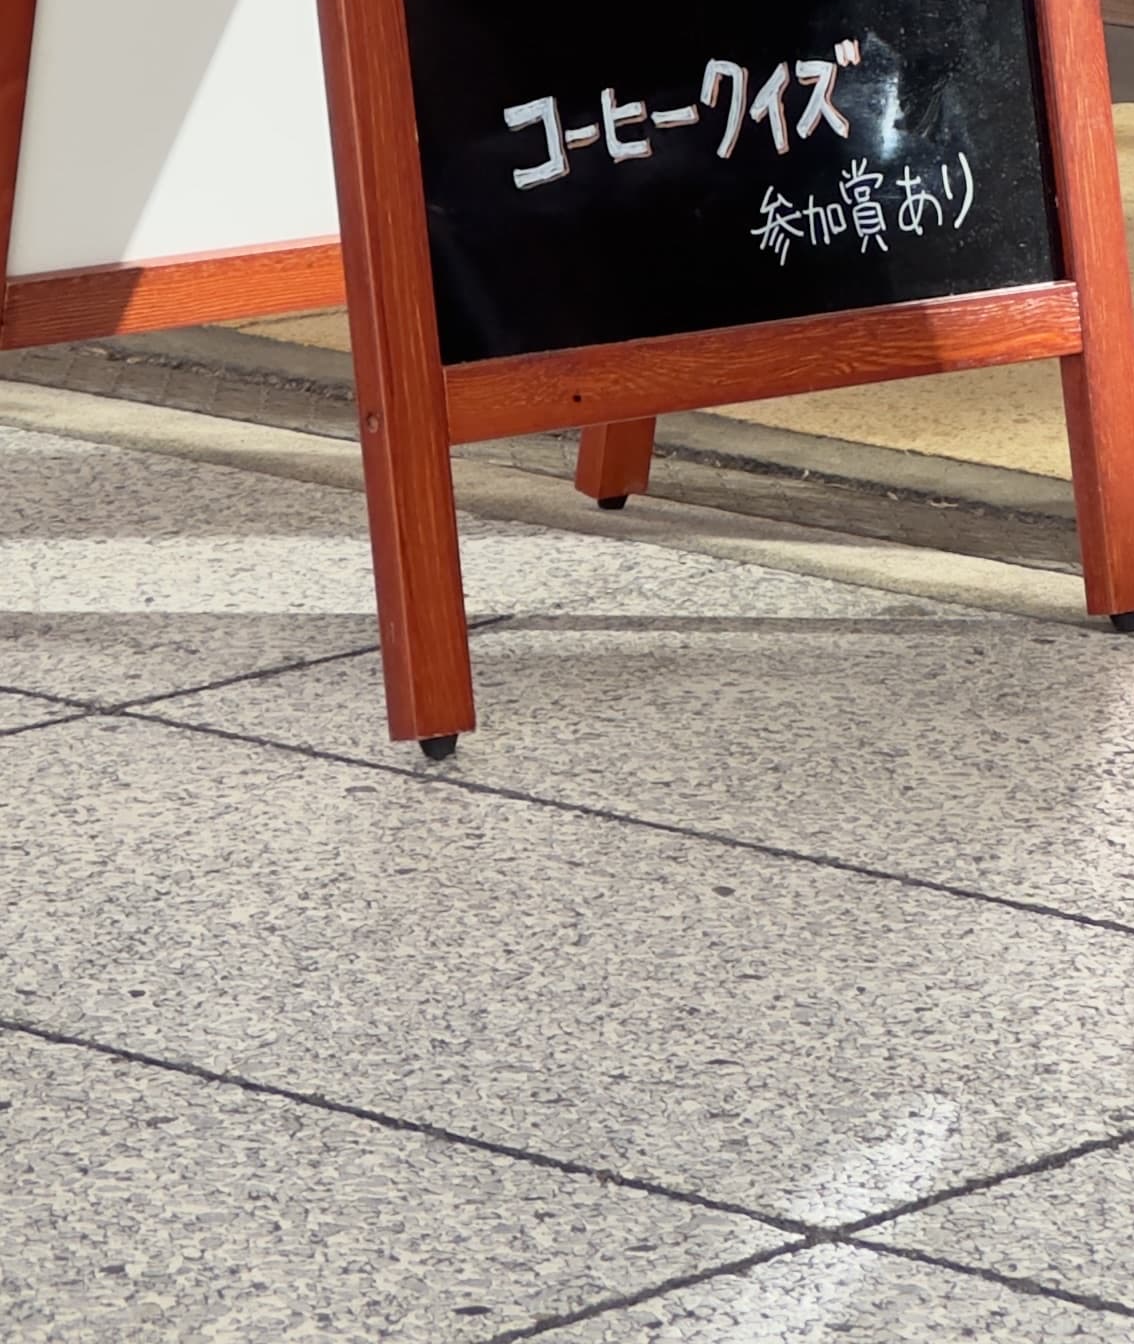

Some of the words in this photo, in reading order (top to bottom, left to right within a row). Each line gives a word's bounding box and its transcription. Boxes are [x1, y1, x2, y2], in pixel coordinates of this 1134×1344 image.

[504, 38, 862, 189] コーヒークイズ
[750, 150, 973, 266] 参加賞あり
